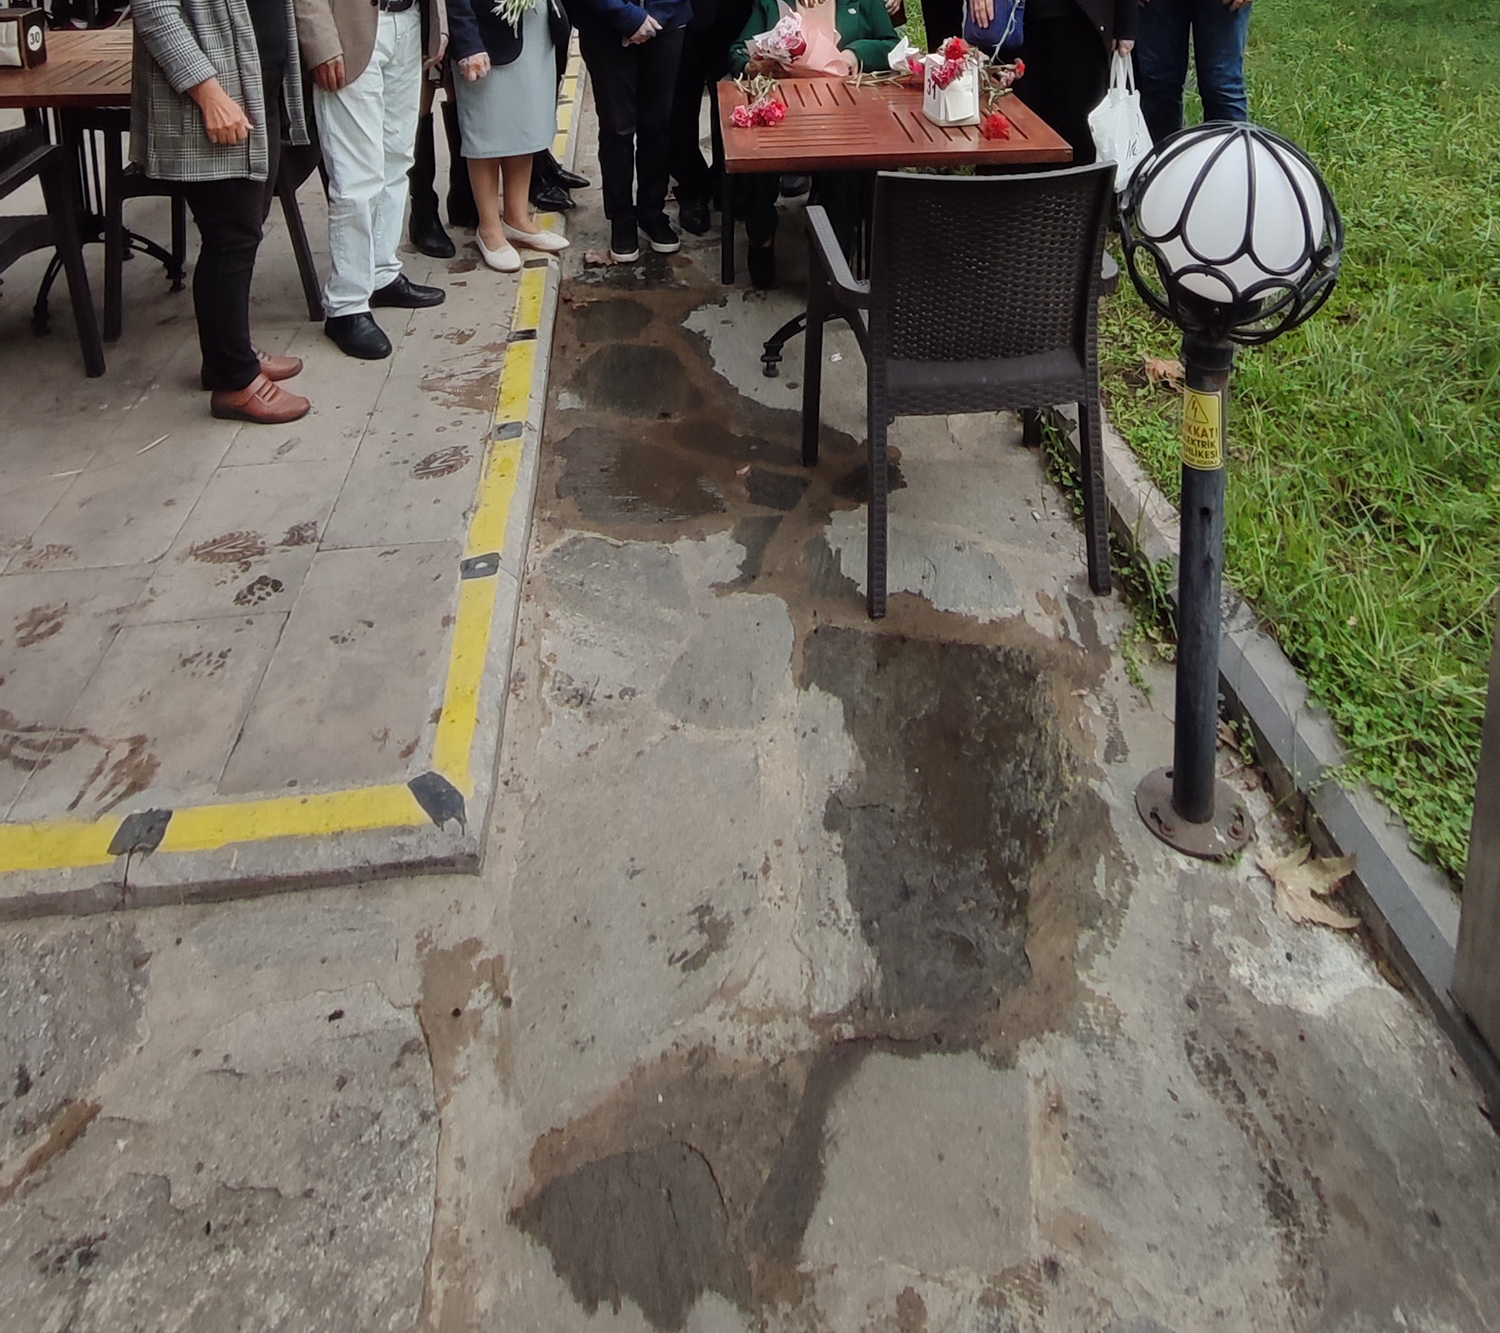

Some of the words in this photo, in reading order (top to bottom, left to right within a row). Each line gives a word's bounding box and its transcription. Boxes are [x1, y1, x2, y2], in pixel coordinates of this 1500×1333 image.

[30, 31, 41, 45] 30
[927, 77, 937, 100] 31
[1186, 424, 1218, 439] KKAT!
